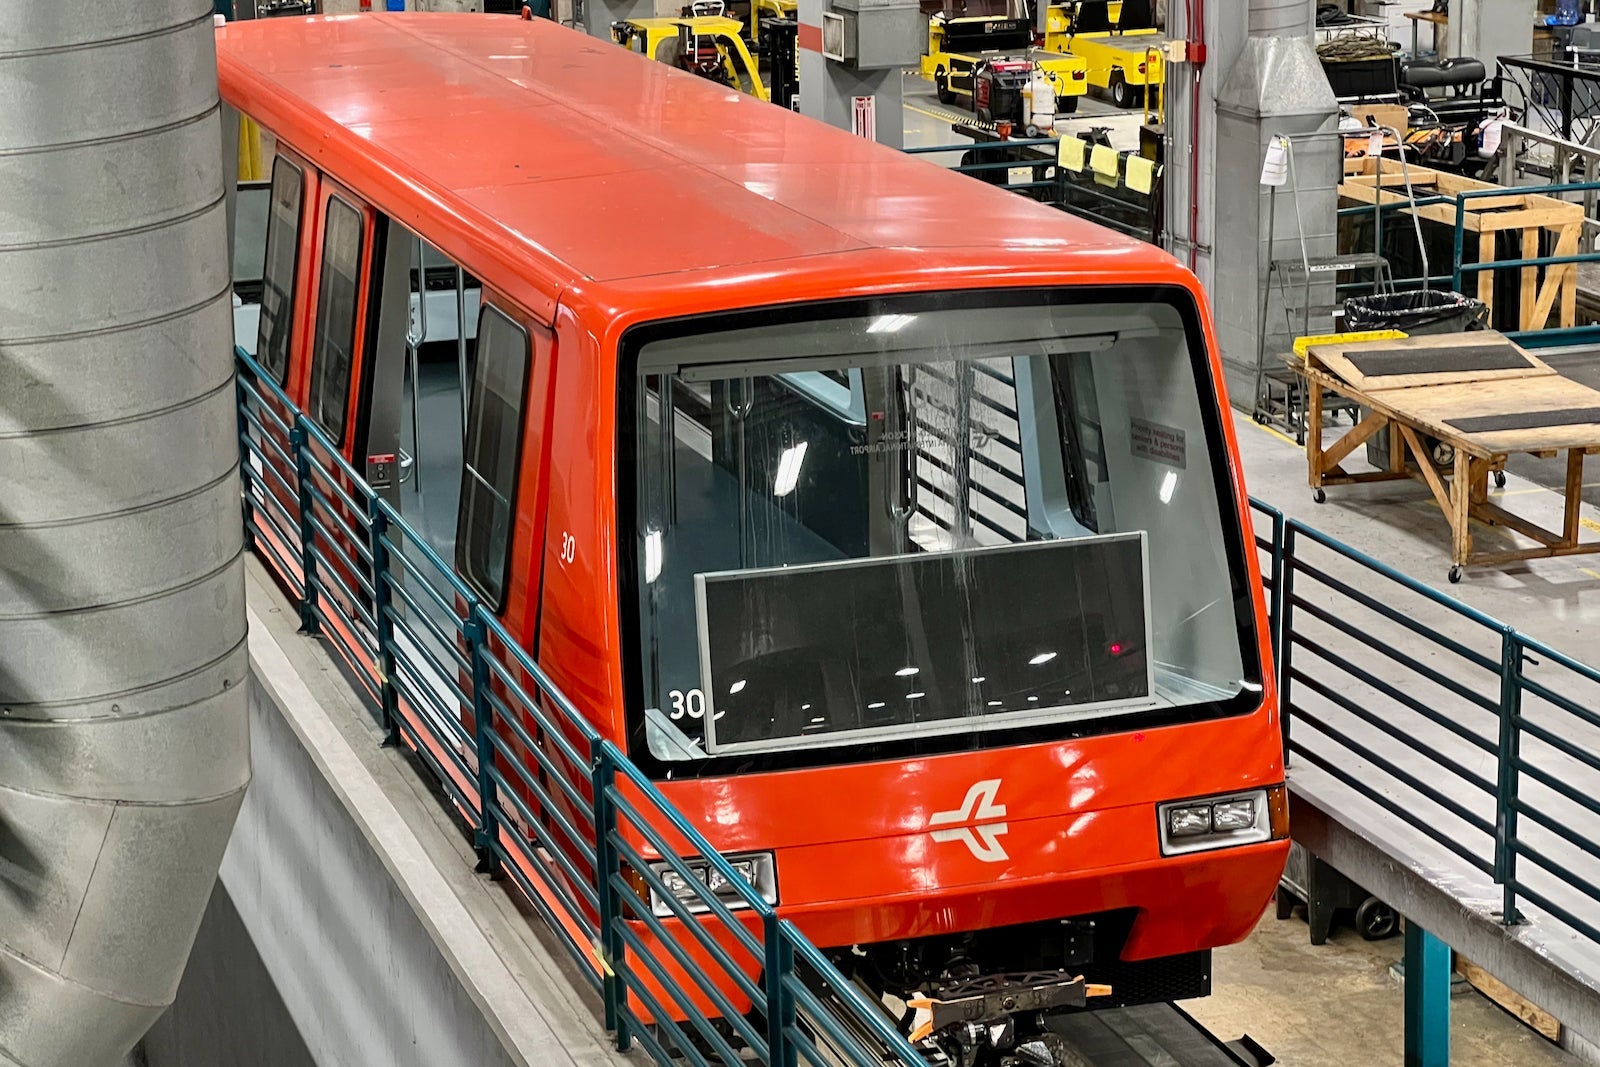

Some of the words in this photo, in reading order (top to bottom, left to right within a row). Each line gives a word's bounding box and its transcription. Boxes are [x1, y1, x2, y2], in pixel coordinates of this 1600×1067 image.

[1160, 441, 1185, 453] persons
[561, 531, 576, 564] 30
[668, 688, 706, 720] 30
